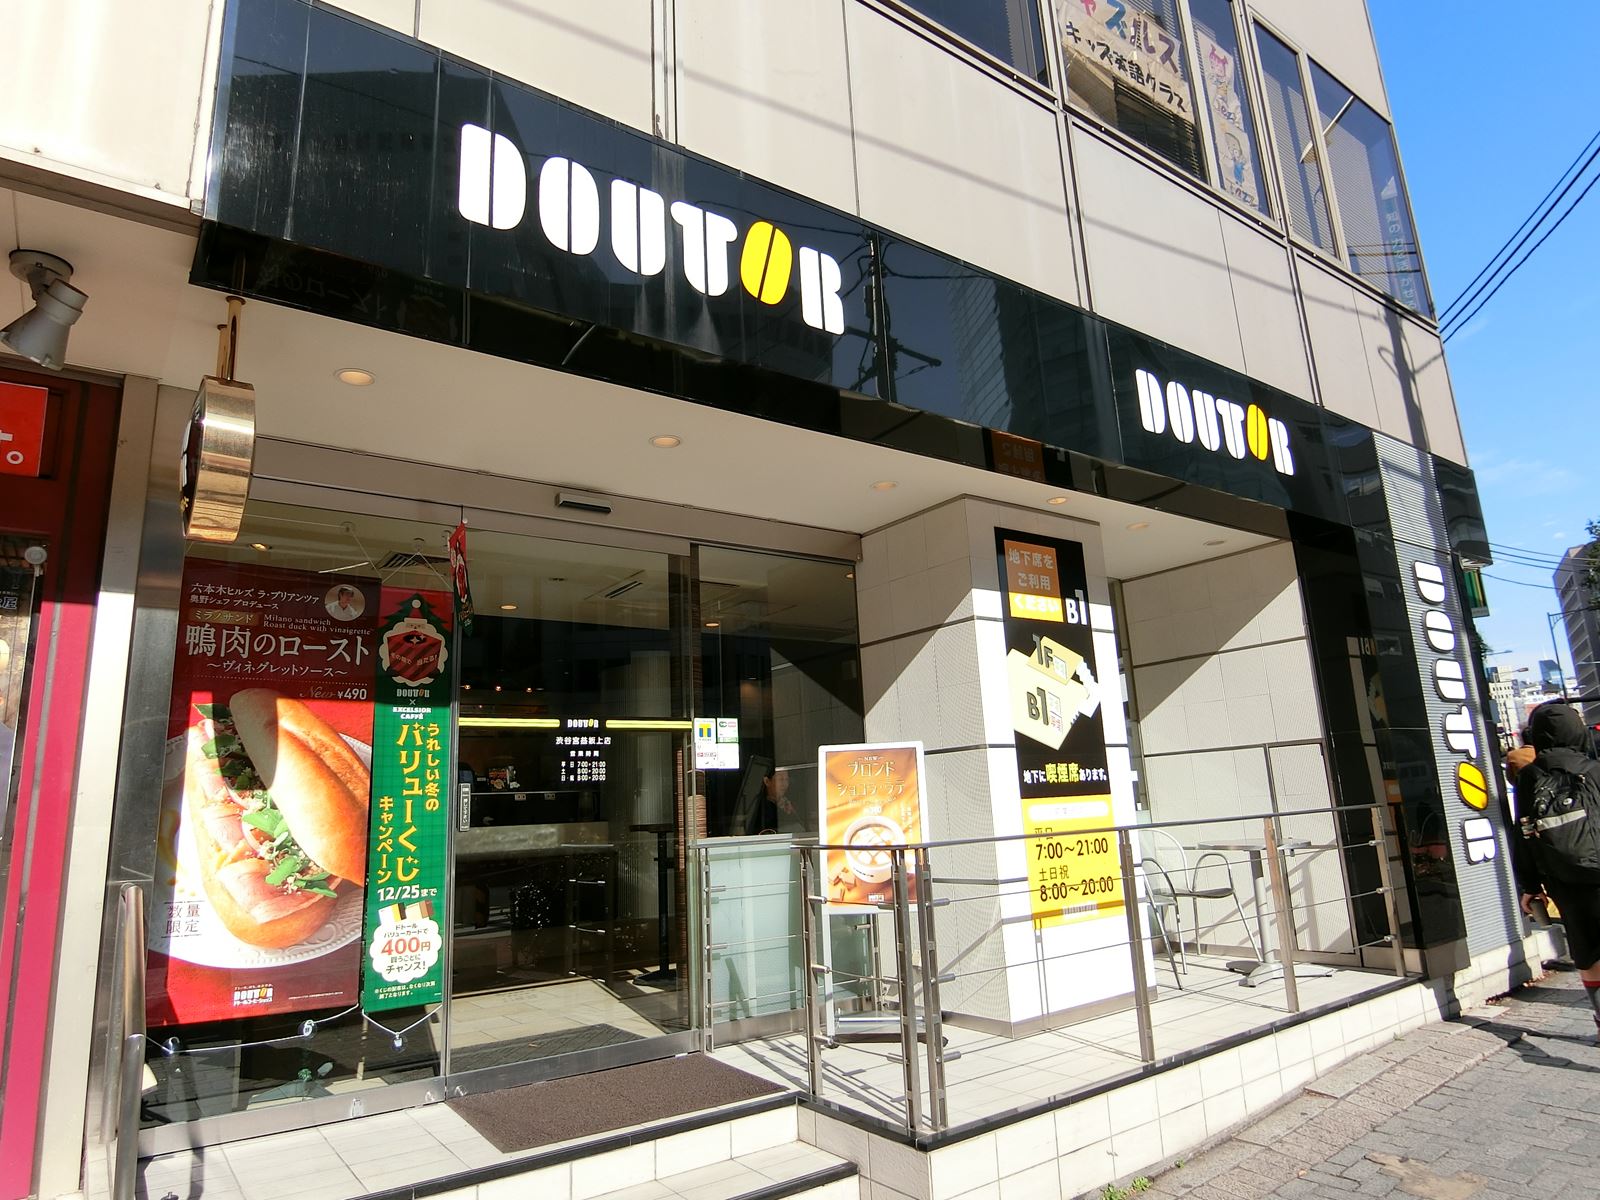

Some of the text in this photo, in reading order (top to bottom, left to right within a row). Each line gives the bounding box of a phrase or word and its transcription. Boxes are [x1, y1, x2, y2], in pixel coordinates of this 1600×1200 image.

[1066, 21, 1187, 113] キッズ英語クラス
[458, 123, 844, 336] DOUTOR
[1135, 369, 1294, 475] DOUTOR
[1008, 548, 1054, 569] 地下席を
[191, 582, 255, 597] 六本木ヒルズ
[1018, 572, 1051, 590] ご利用
[233, 598, 279, 610] プロデュース
[1065, 589, 1088, 626] B1
[195, 609, 255, 624] ミラノサンド
[264, 614, 331, 626] Milano sandwich
[263, 621, 371, 636] Roast duck with vinaigrette
[186, 623, 369, 666] 鴨肉のロースト
[337, 688, 368, 700] ¥490
[396, 688, 430, 697] DOUTOR
[1026, 686, 1050, 726] B1
[1413, 560, 1496, 864] DOUTOR
[425, 723, 441, 811] うれしい冬の
[1023, 763, 1107, 783] 地下に喫煙席あります。
[376, 796, 394, 884] キャンペーン
[1039, 865, 1069, 882] 土日祝
[377, 884, 437, 901] 12/25まで
[167, 904, 200, 918] 数量
[166, 919, 200, 935] 限定
[381, 936, 431, 955] 400円
[386, 960, 426, 974] チャンス!
